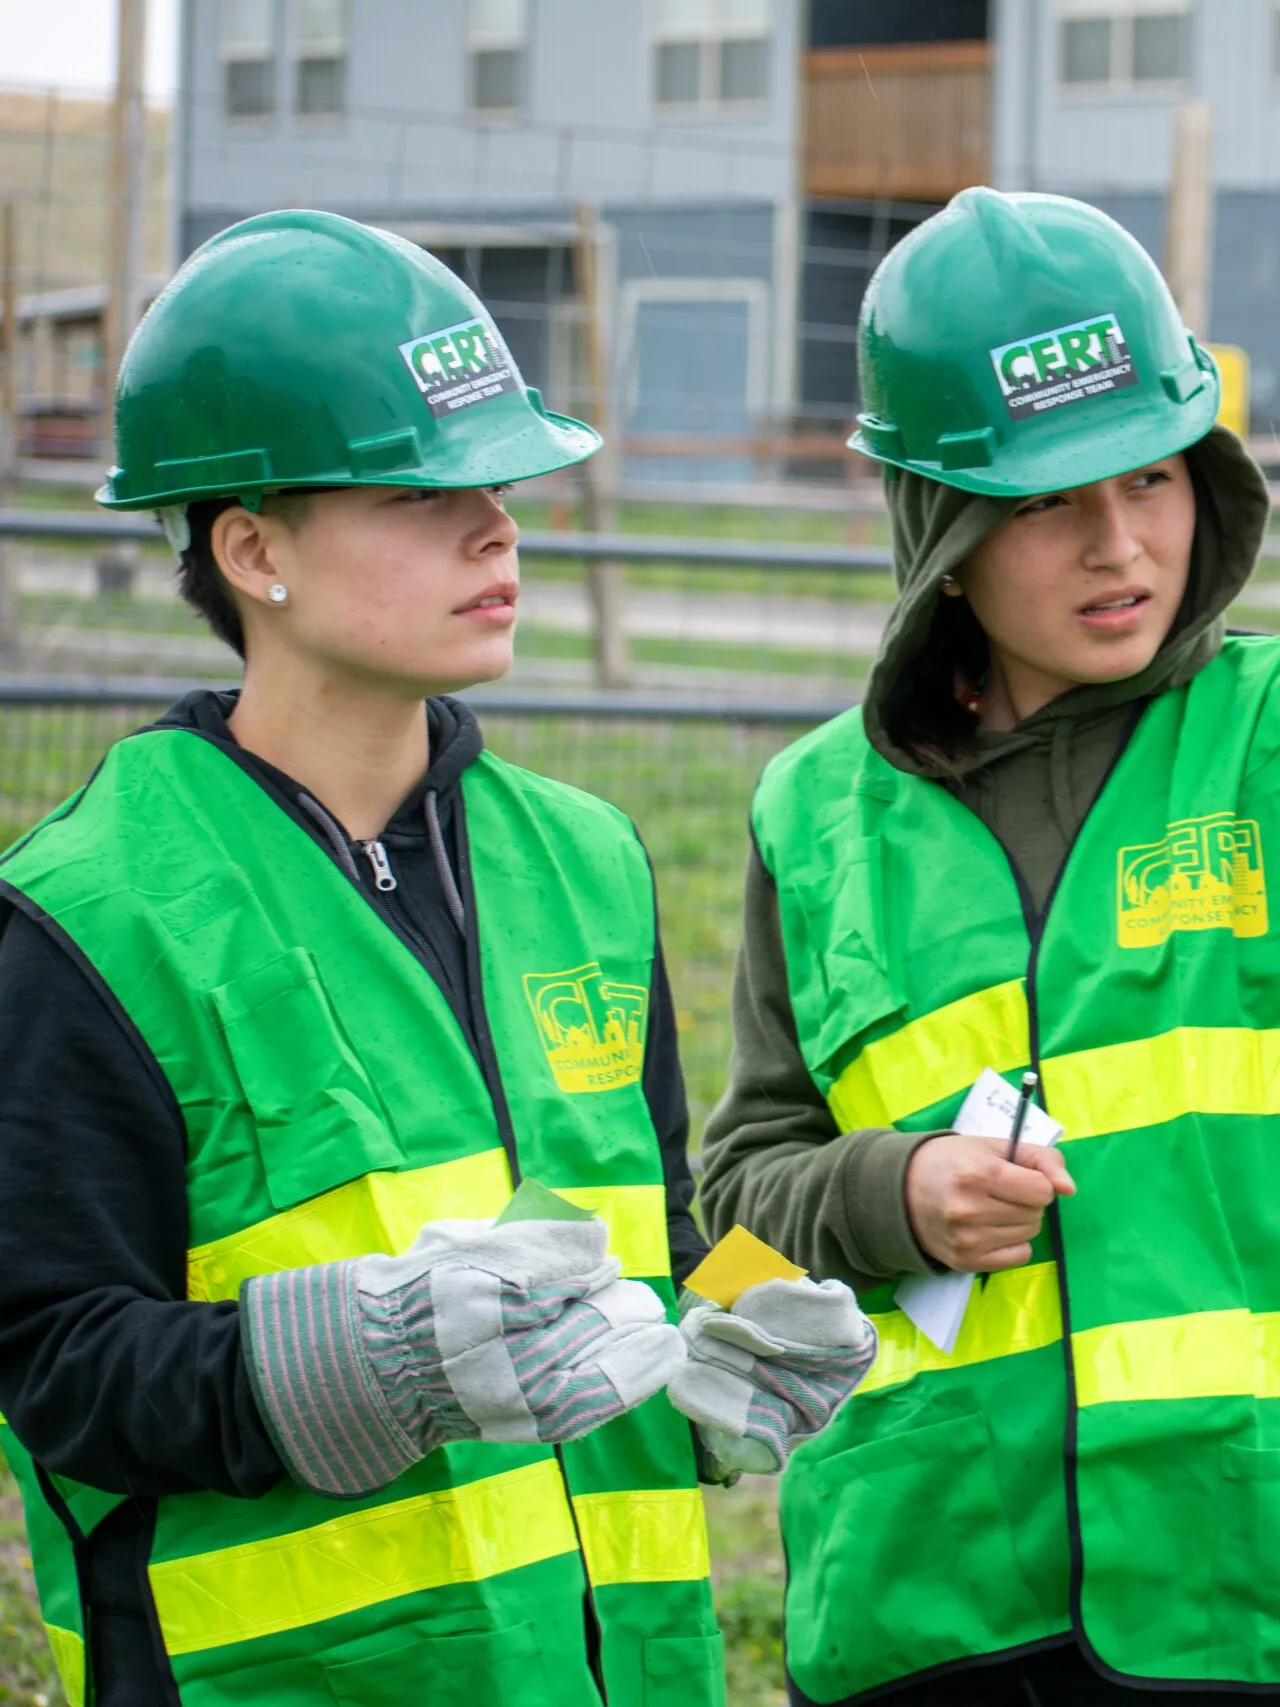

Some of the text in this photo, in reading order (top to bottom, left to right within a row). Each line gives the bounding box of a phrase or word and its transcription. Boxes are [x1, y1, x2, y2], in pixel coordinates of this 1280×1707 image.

[427, 370, 512, 405] COMMUNITY EMERGENCY
[447, 384, 504, 409] RESPONSE TEAM
[1008, 364, 1132, 407] COMMUNITY EMERGENCY
[1032, 380, 1116, 411] RESPONSE TEAM
